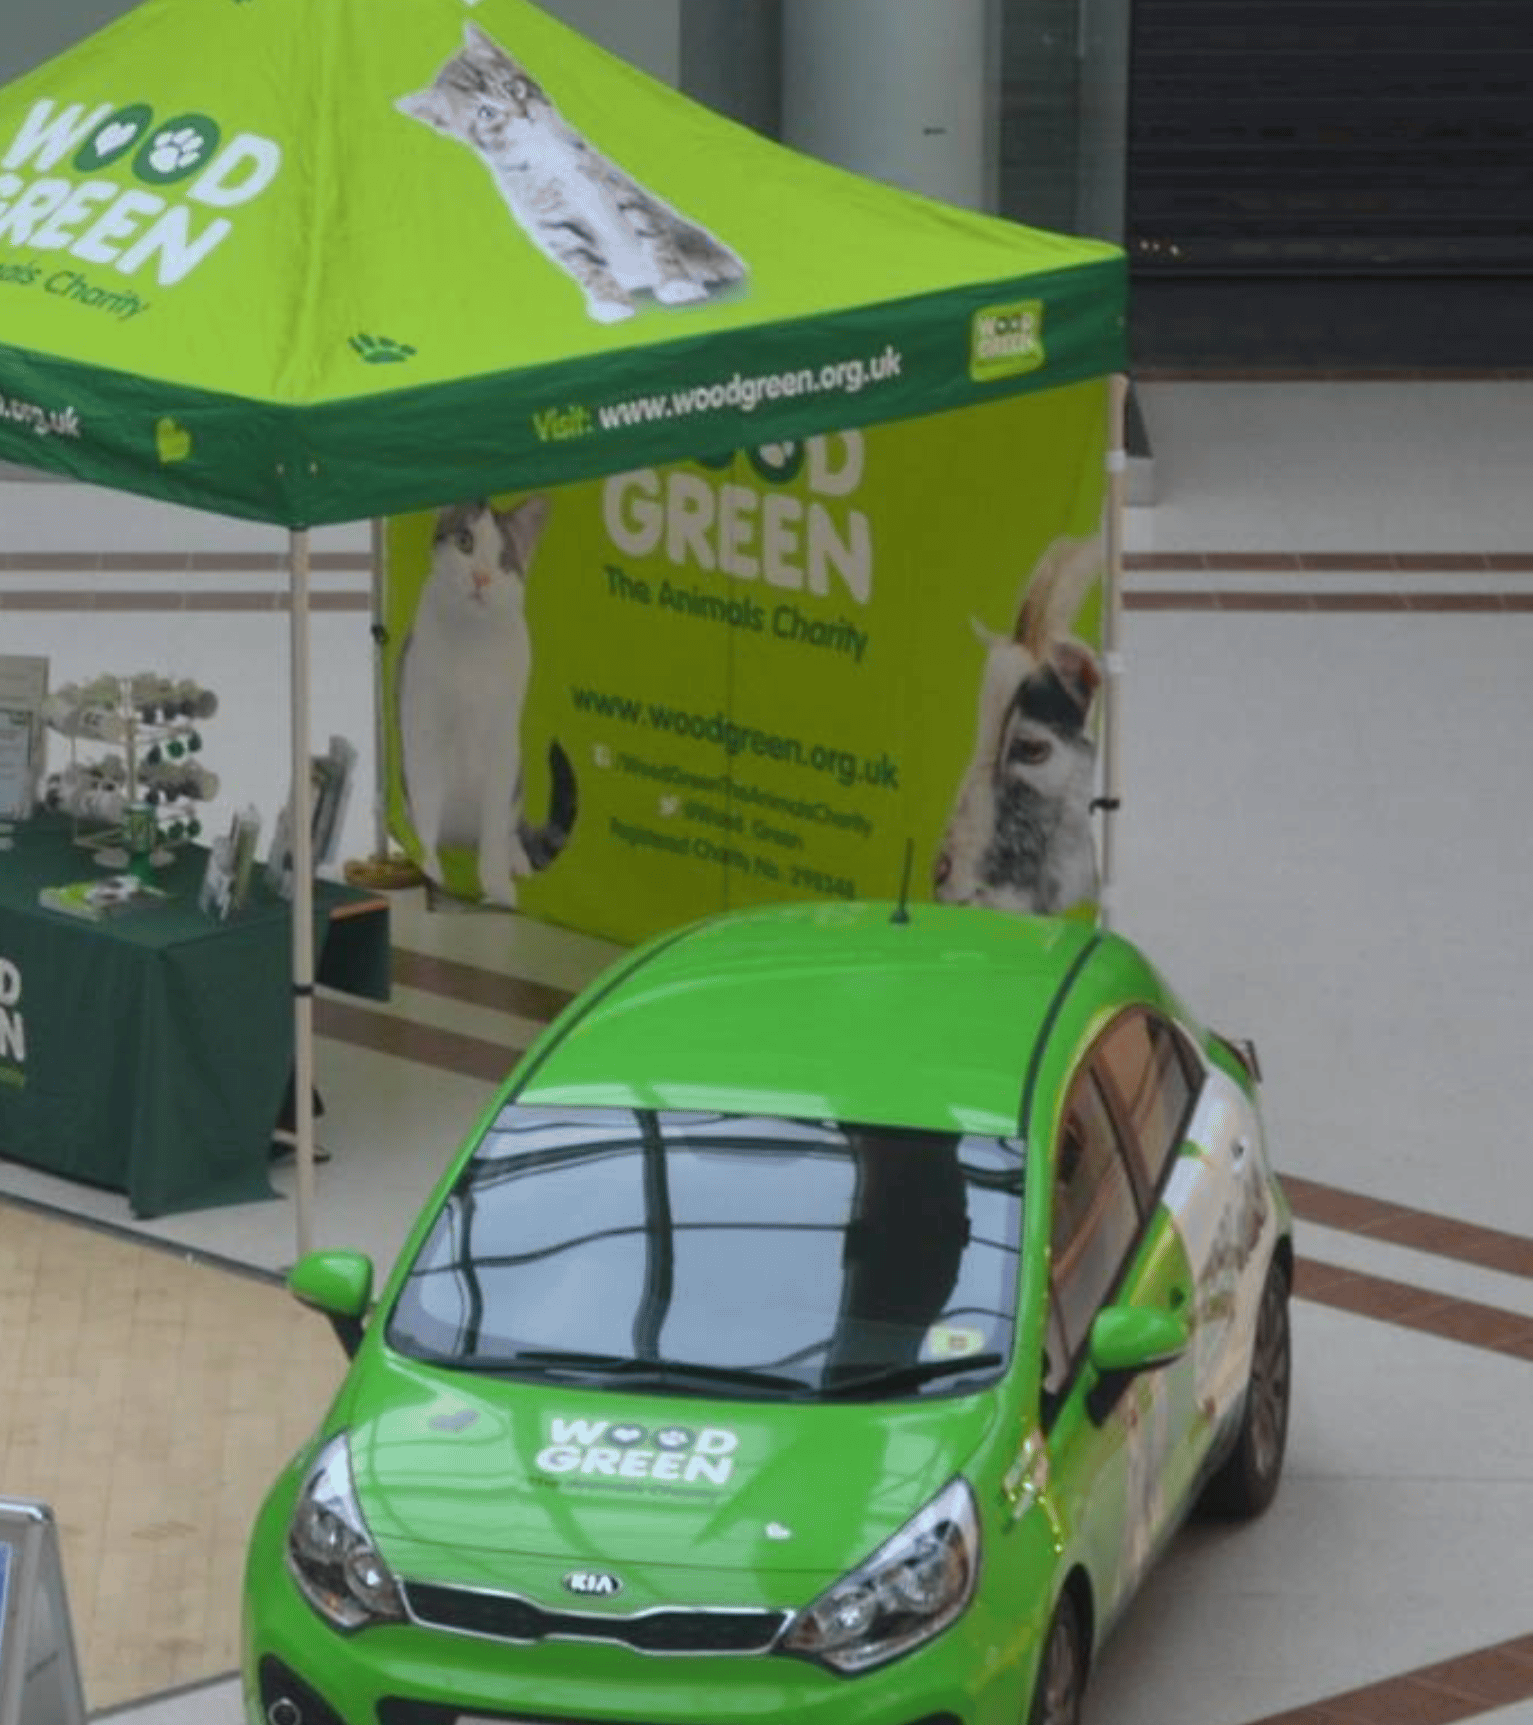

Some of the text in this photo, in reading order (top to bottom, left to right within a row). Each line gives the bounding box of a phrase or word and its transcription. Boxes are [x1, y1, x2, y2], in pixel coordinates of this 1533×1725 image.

[0, 99, 281, 206] WOOD
[599, 344, 902, 429] www.woodgreen.org.uk
[602, 469, 872, 604] GREEN
[604, 563, 869, 663] The Animals Charity
[569, 684, 899, 790] www.woodgreen.org.uk
[536, 1445, 733, 1484] GREEN
[551, 1418, 739, 1455] WOOD
[570, 1574, 613, 1592] KIA
